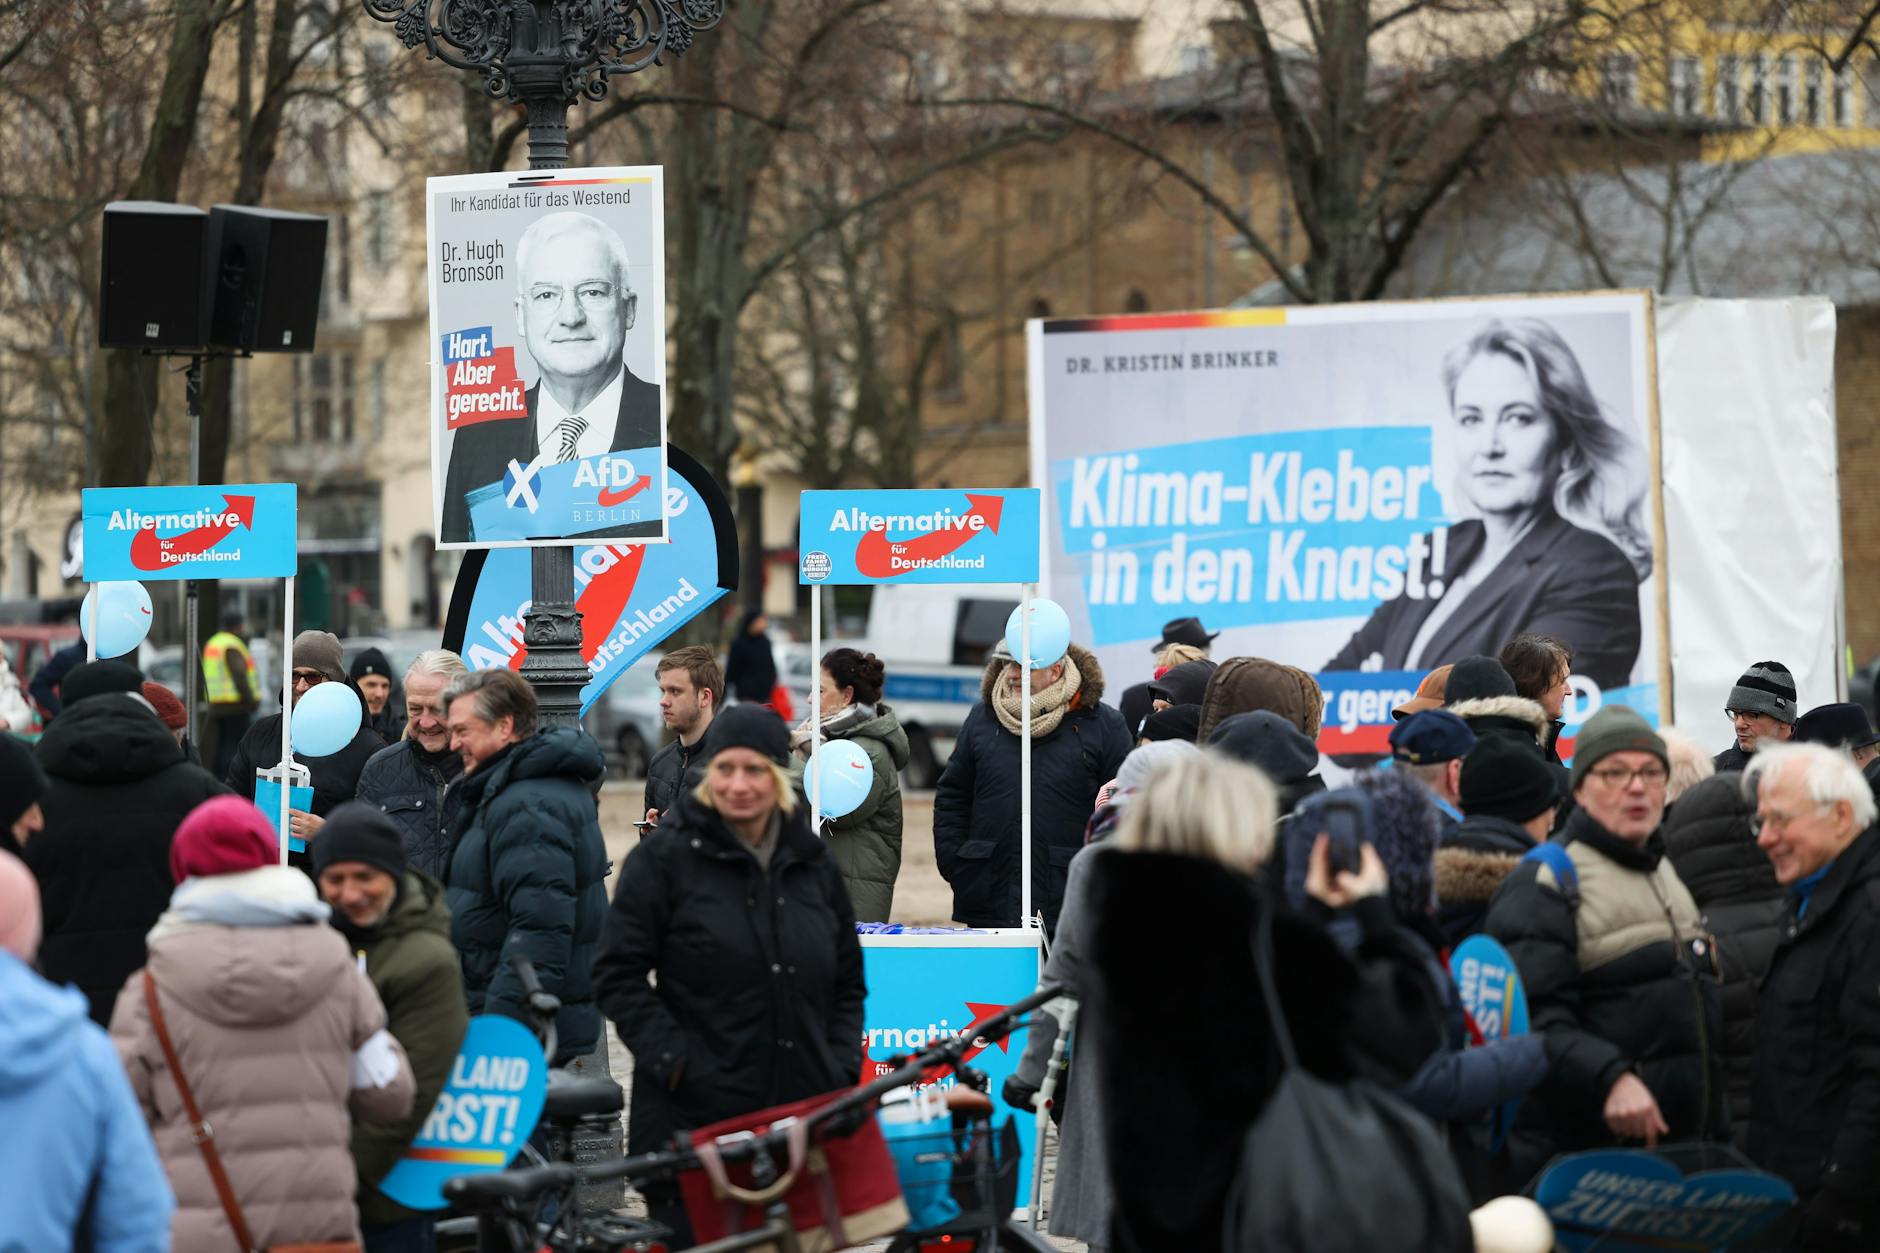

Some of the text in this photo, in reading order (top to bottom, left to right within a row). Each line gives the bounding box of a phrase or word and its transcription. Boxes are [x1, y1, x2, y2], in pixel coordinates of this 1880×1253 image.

[451, 188, 631, 213] Ihr Kandidat für das Westend
[442, 239, 504, 264] Dr. Hugh
[442, 263, 504, 283] Bronson
[448, 333, 492, 359] Hart.
[452, 360, 496, 386] Aber
[1065, 350, 1280, 374] DR. KRISTIN BRINKER
[449, 385, 524, 421] gerecht.
[572, 456, 636, 488] AfD
[1068, 449, 1434, 531] Klima-Kleber
[107, 507, 241, 531] Alternative
[572, 509, 641, 523] BERLIN
[829, 507, 985, 532] Alternative
[160, 540, 175, 550] für
[160, 549, 241, 563] Deutschland
[891, 544, 907, 554] für
[891, 554, 985, 569] Deutschland
[1088, 527, 1449, 606] in den Knast!
[587, 577, 699, 673] utschland
[451, 1054, 530, 1092] LAND
[418, 1092, 521, 1145] RST!
[1577, 1168, 1685, 1202] UNSER
